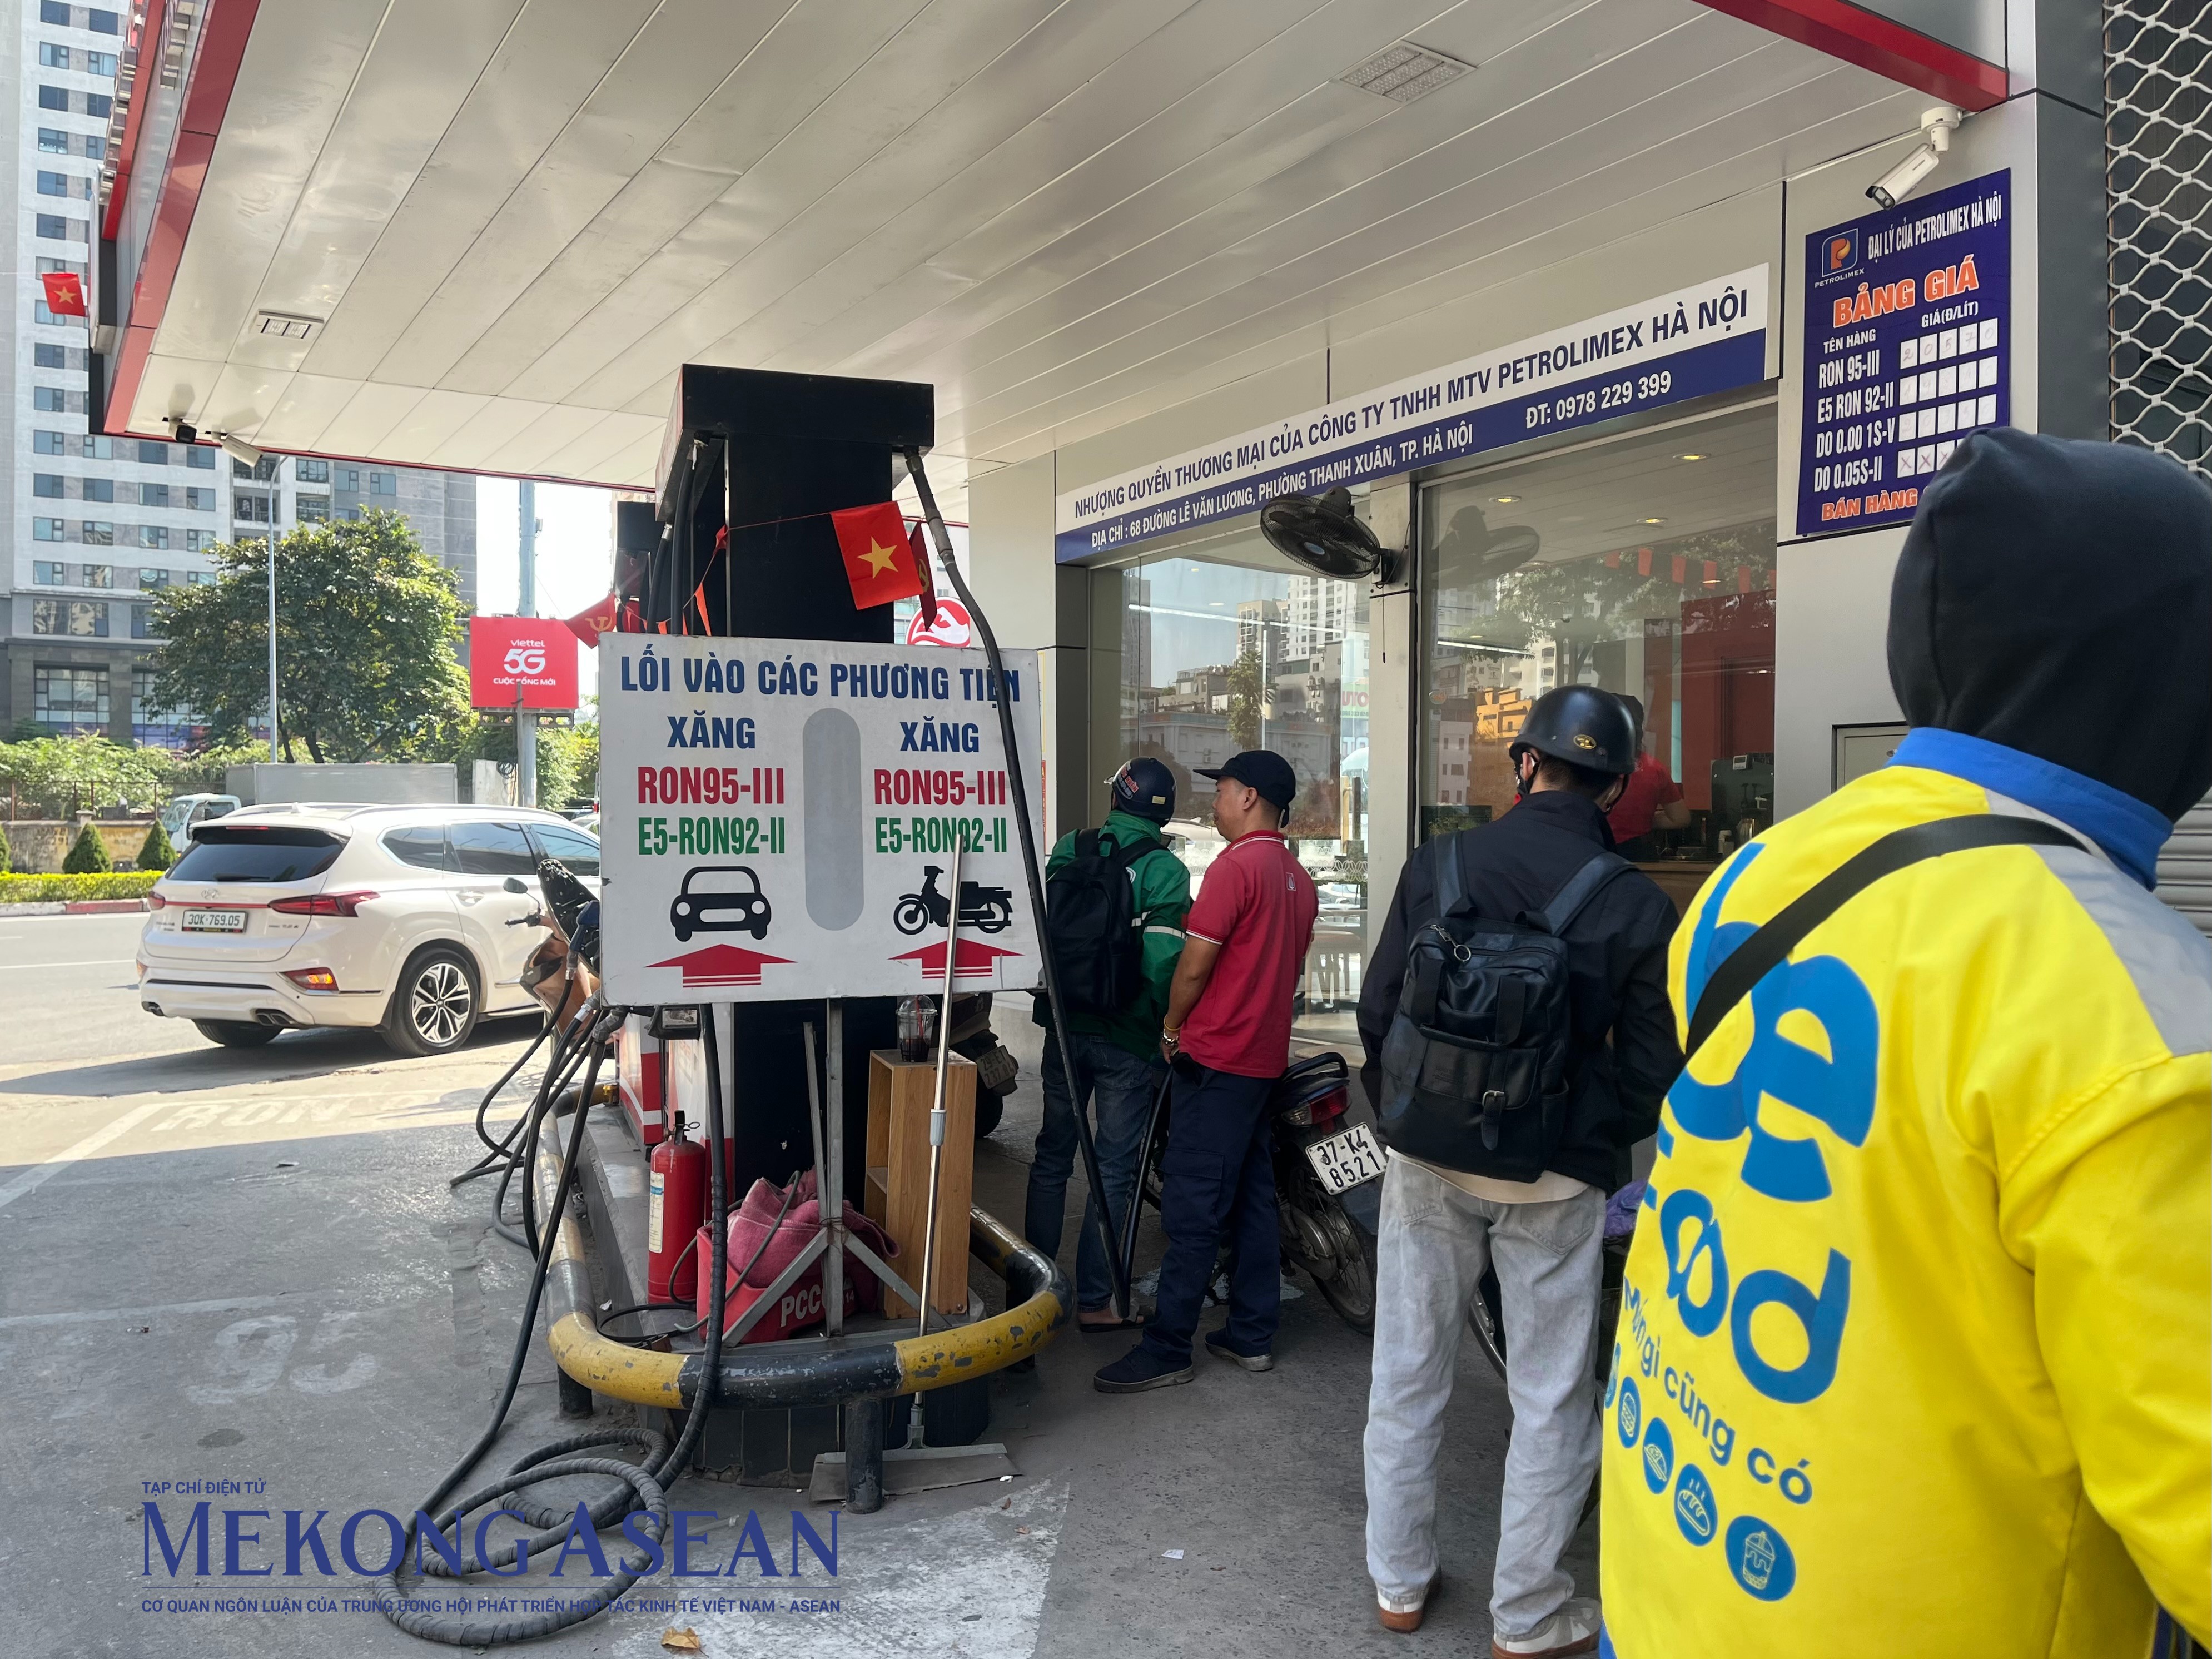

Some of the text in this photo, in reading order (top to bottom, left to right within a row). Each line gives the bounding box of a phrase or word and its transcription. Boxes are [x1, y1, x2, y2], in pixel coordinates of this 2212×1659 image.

[1868, 191, 2002, 264] ĐẠI LÝ CỦA PETROLIMEX HÀ NỘI
[1815, 267, 1865, 289] PETROLIMEX
[1833, 254, 1979, 328] BẢNG GIÁ
[1921, 301, 1979, 328] GIÁ(Đ/LÍT)
[1823, 329, 1876, 354] TÊN HÀNG
[1819, 359, 1844, 389] RON
[1847, 349, 1880, 382] 95-III
[1075, 286, 1747, 518] NHƯỢNG QUYỀN THƯƠNG MẠI CỦA CÔNG TY TNHH MTV PETROLIMEX HÀ NỘI
[1525, 370, 1672, 429] ĐT: 0978 229 399
[1817, 396, 1833, 423] E5
[1836, 389, 1861, 419] RON
[1865, 381, 1894, 413] 92-II
[1836, 425, 1862, 454] 0.00
[1091, 529, 1107, 551] ĐỊA
[1109, 518, 1123, 542] CHỈ
[1130, 524, 1141, 537] 68
[1142, 509, 1177, 534] ĐƯỜNG
[1179, 501, 1190, 523] LÊ
[1192, 495, 1214, 519] VĂN
[1216, 486, 1256, 514] LƯƠNG,
[1259, 471, 1306, 502] PHƯỜNG
[1310, 458, 1351, 487] THANH
[1354, 444, 1396, 475] XUÂN,
[1400, 440, 1419, 462] TP.
[1423, 428, 1443, 456] HÀ
[1447, 420, 1473, 453] NỘI
[1833, 455, 1883, 489] 0.05S-II
[1821, 488, 1918, 521] BÁN HÀNG
[503, 648, 546, 674] 5G
[510, 639, 545, 648] viettel
[493, 677, 515, 686] CUỘC
[540, 677, 556, 686] MỚI
[621, 643, 670, 692] LỐI
[683, 652, 745, 694] VÀO
[757, 655, 818, 697] CÁC
[830, 662, 949, 701] PHƯƠNG
[667, 709, 980, 753] XĂNG XĂNG
[638, 766, 1006, 806] RON95-III RON95-III
[638, 816, 786, 856] E5-RON92-II
[1329, 1150, 1380, 1188] 8521
[1664, 1365, 1736, 1467] cũng
[1747, 1447, 1813, 1505] có
